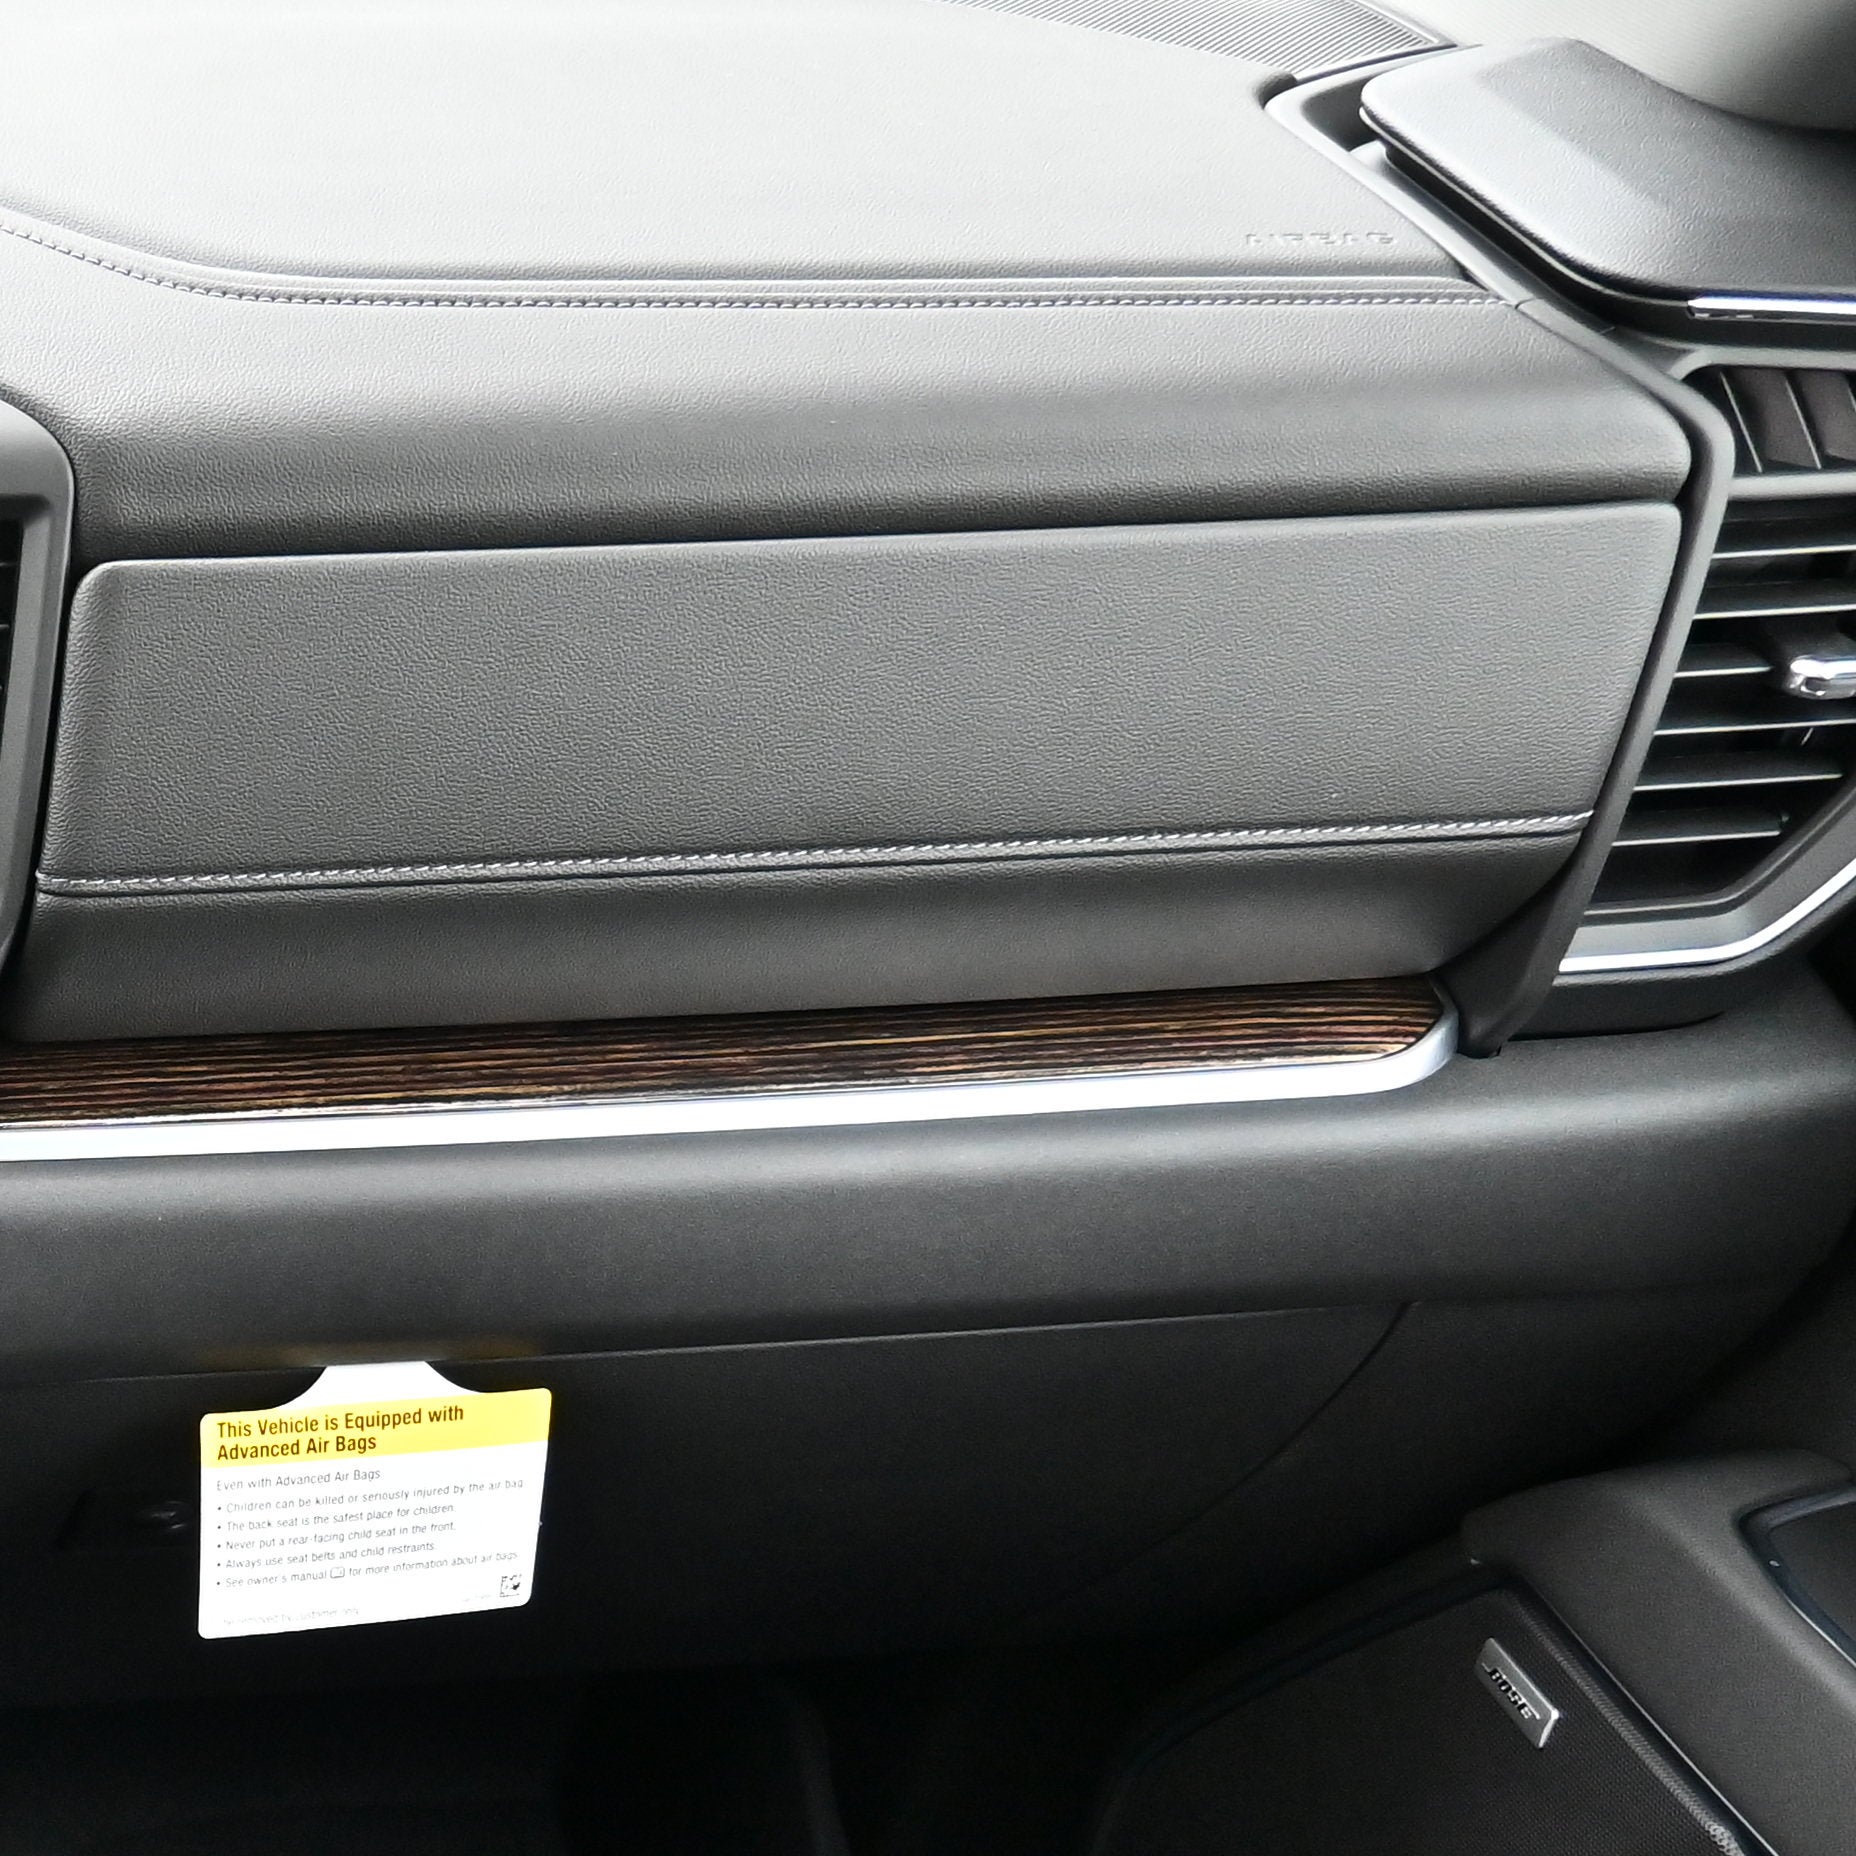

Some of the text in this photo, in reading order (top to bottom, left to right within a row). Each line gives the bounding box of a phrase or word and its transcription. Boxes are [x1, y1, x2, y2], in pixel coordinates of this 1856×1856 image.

[217, 1405, 465, 1439] This Vehicle is Equipped with
[217, 1434, 377, 1461] Advanced Air Bags
[216, 1469, 382, 1492] Even with Advanced Air Bags
[225, 1501, 273, 1514] Children
[275, 1500, 296, 1510] can
[298, 1497, 312, 1508] be
[314, 1495, 345, 1506] killed
[347, 1494, 359, 1504] or
[361, 1489, 410, 1503] seriously
[413, 1485, 450, 1499] injured
[453, 1484, 466, 1496] by
[468, 1482, 486, 1493] the
[226, 1521, 246, 1533] The
[248, 1519, 273, 1531] back
[276, 1517, 298, 1529] seat
[313, 1514, 330, 1525] the
[332, 1511, 364, 1523] safest
[366, 1508, 394, 1522] place
[396, 1507, 411, 1518] for
[225, 1539, 256, 1551] Never
[259, 1537, 276, 1553] put
[287, 1532, 346, 1546] rear-facing
[347, 1529, 373, 1541] child
[375, 1527, 397, 1539] seat
[399, 1525, 409, 1535] in
[411, 1524, 427, 1534] the
[225, 1558, 262, 1570] Always
[265, 1556, 284, 1567] use
[286, 1553, 309, 1565] seat
[311, 1551, 336, 1563] belts
[338, 1549, 358, 1560] and
[360, 1546, 385, 1558] child
[290, 1570, 328, 1582] manual
[348, 1566, 363, 1577] for
[365, 1564, 390, 1576] more
[393, 1558, 448, 1572] information
[450, 1555, 478, 1567] about
[1485, 1664, 1538, 1720] BOSE
